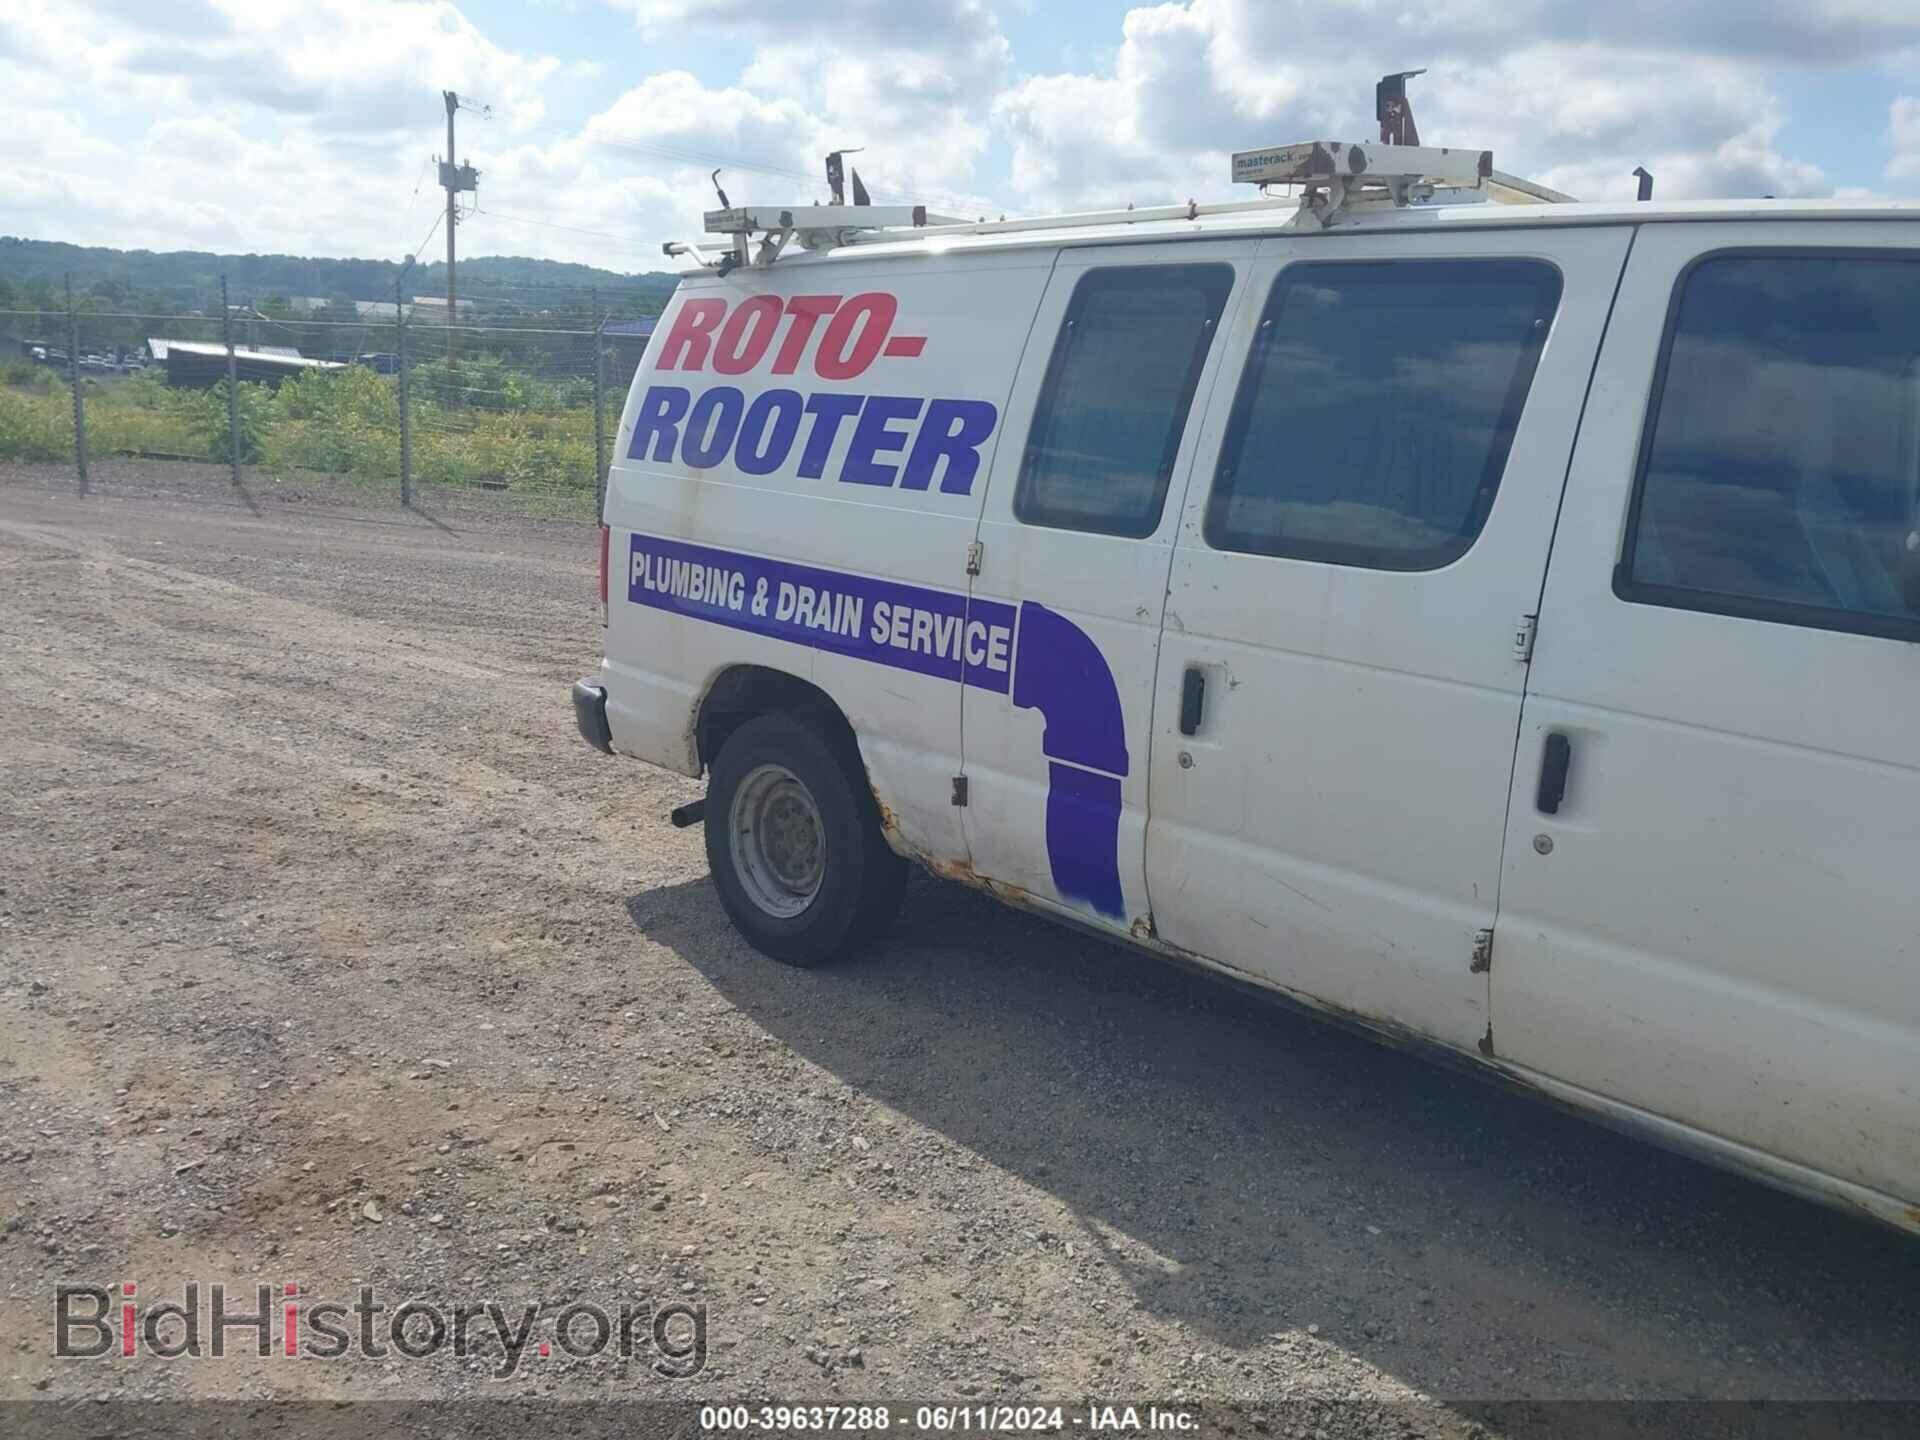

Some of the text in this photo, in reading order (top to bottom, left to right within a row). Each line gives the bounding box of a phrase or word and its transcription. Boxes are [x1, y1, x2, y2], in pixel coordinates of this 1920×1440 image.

[1236, 152, 1293, 168] masterack
[655, 293, 928, 380] ROTO-
[627, 386, 998, 496] ROOTER
[631, 552, 1011, 672] PLUMBING & DRAIN SERVICE
